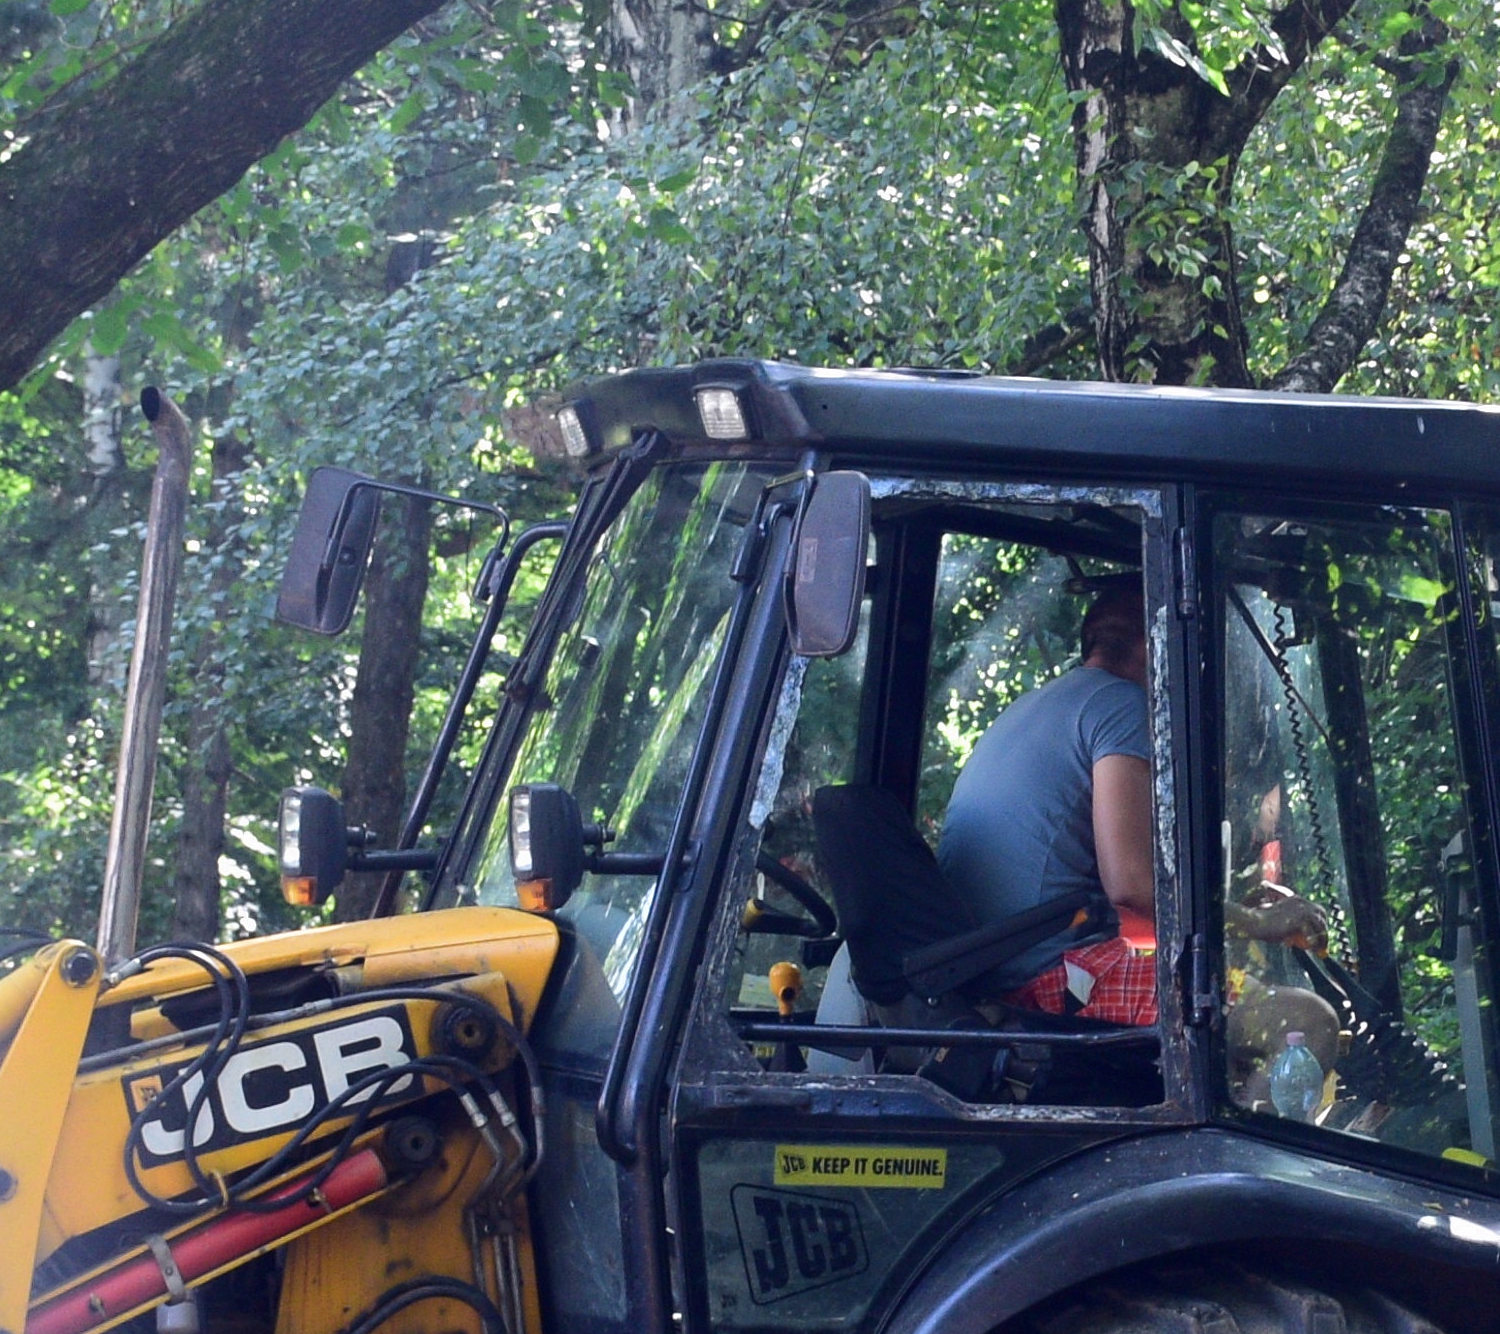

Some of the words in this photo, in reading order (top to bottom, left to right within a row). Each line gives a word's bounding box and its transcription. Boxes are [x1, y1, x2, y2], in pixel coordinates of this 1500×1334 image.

[141, 1017, 414, 1155] JCB
[782, 1155, 806, 1175] JCB
[812, 1157, 851, 1175] KEEP
[854, 1158, 869, 1176] IT
[872, 1158, 943, 1177] GENUINE.
[753, 1197, 858, 1294] JCB
